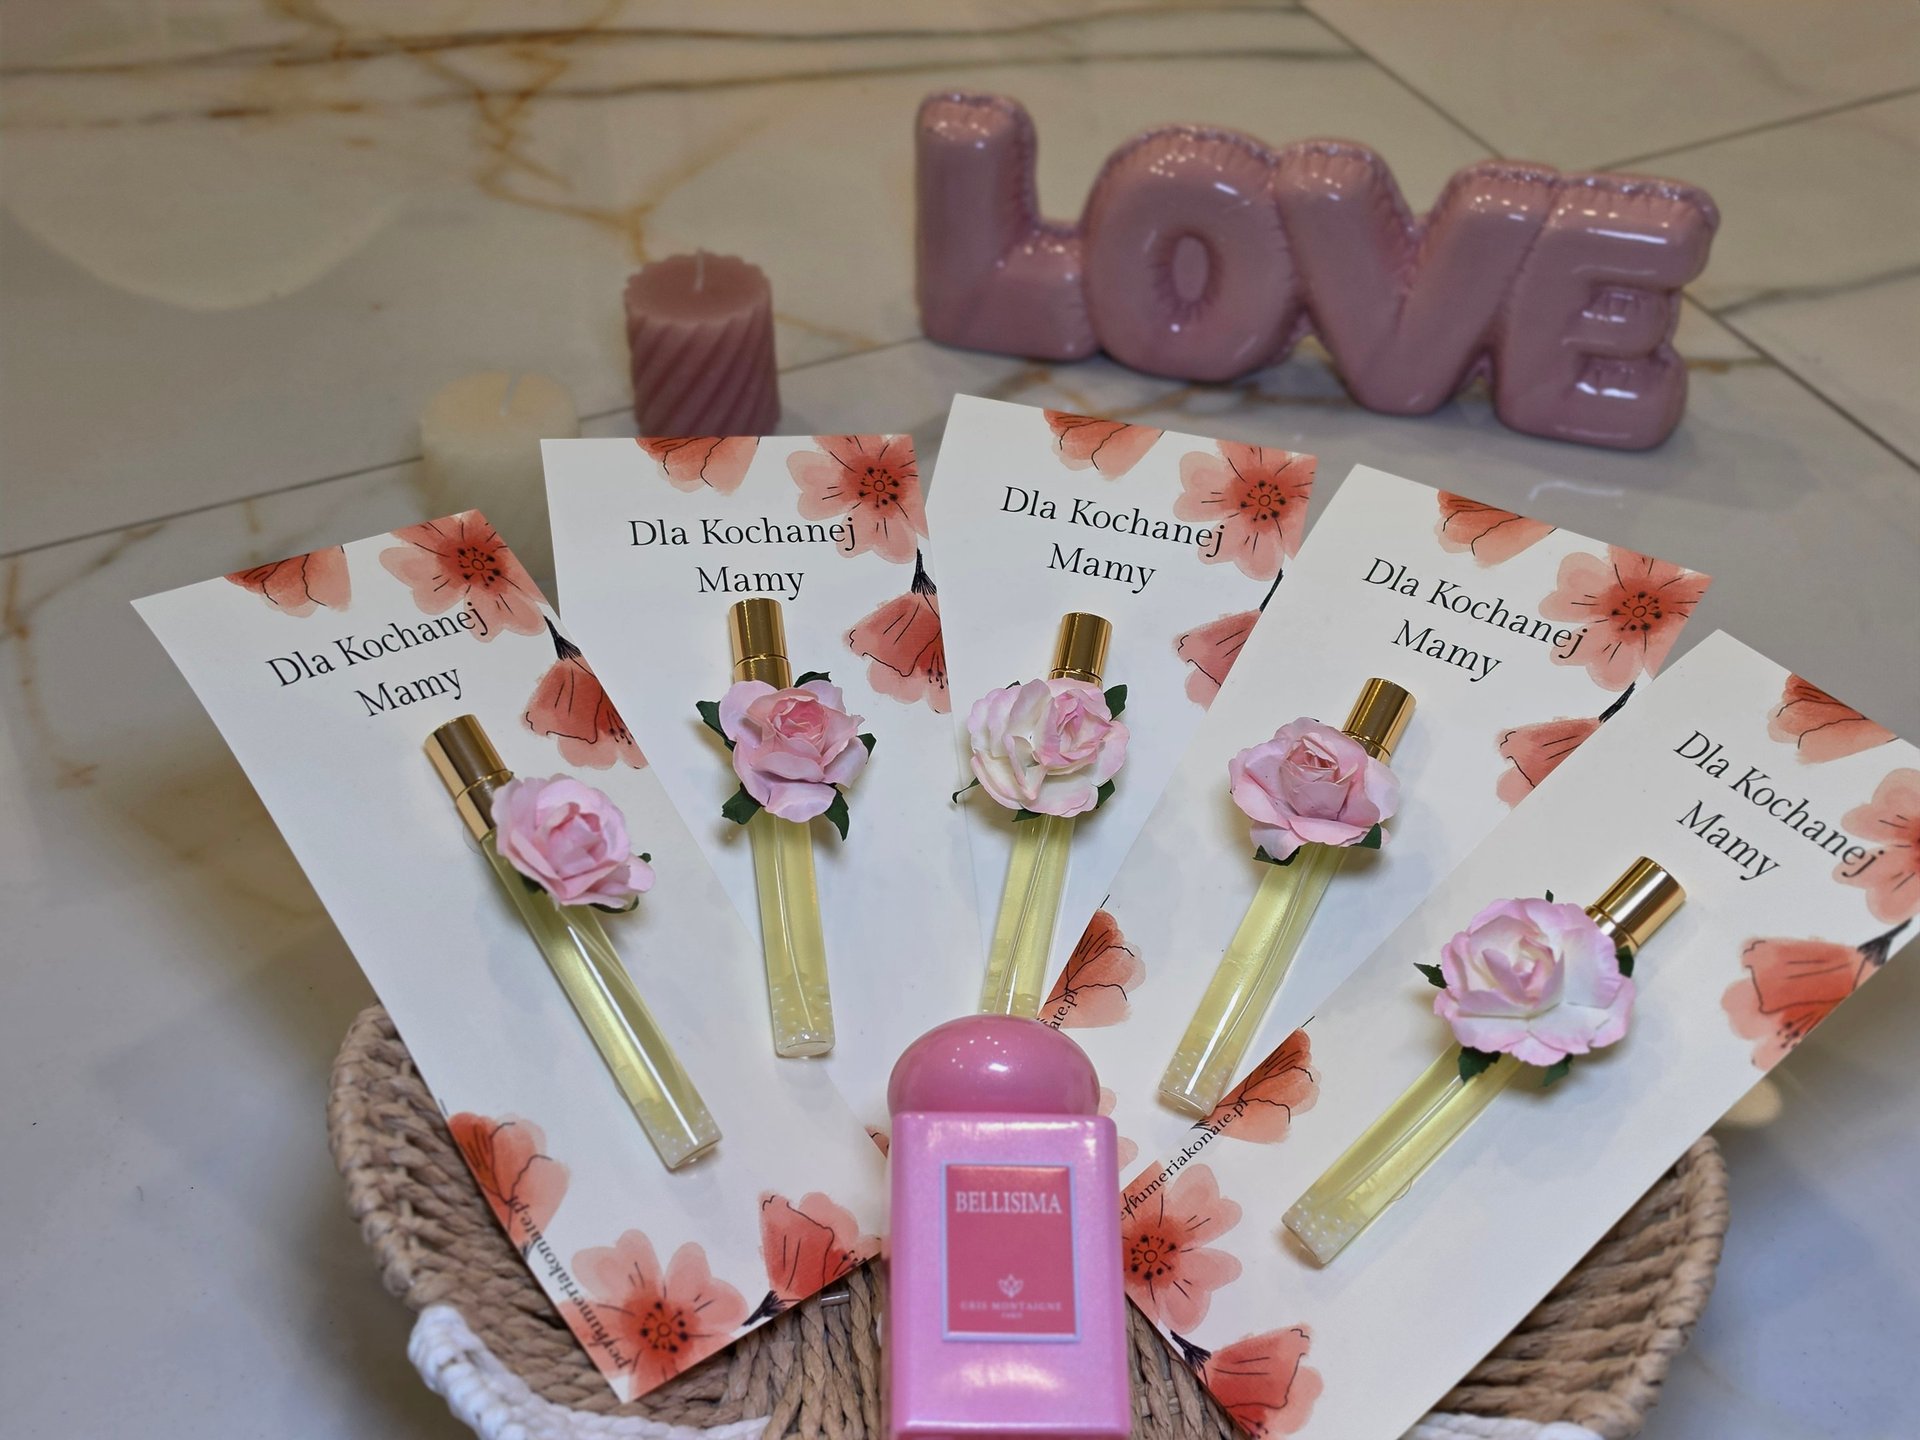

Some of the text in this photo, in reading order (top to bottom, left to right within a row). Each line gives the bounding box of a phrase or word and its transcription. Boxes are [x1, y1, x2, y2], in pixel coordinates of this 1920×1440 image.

[914, 91, 1721, 452] LOVE
[628, 516, 856, 551] Dla Kochanej
[1000, 486, 1225, 558] Dla Kochanej
[695, 565, 805, 601] Mamy
[1046, 542, 1157, 594] Mamy
[265, 601, 488, 687] Dla Kochanej
[1362, 557, 1588, 659] Dla Kochanej
[1391, 619, 1502, 682] Mamy
[354, 668, 463, 717] Mamy
[1673, 730, 1885, 878] Dla Kochanej
[1676, 799, 1780, 881] Mamy
[1120, 1097, 1248, 1221] erfumeriakonate.pl
[955, 1190, 1062, 1214] BELLISIMA
[510, 1194, 632, 1369] perfumeriakonate.pl
